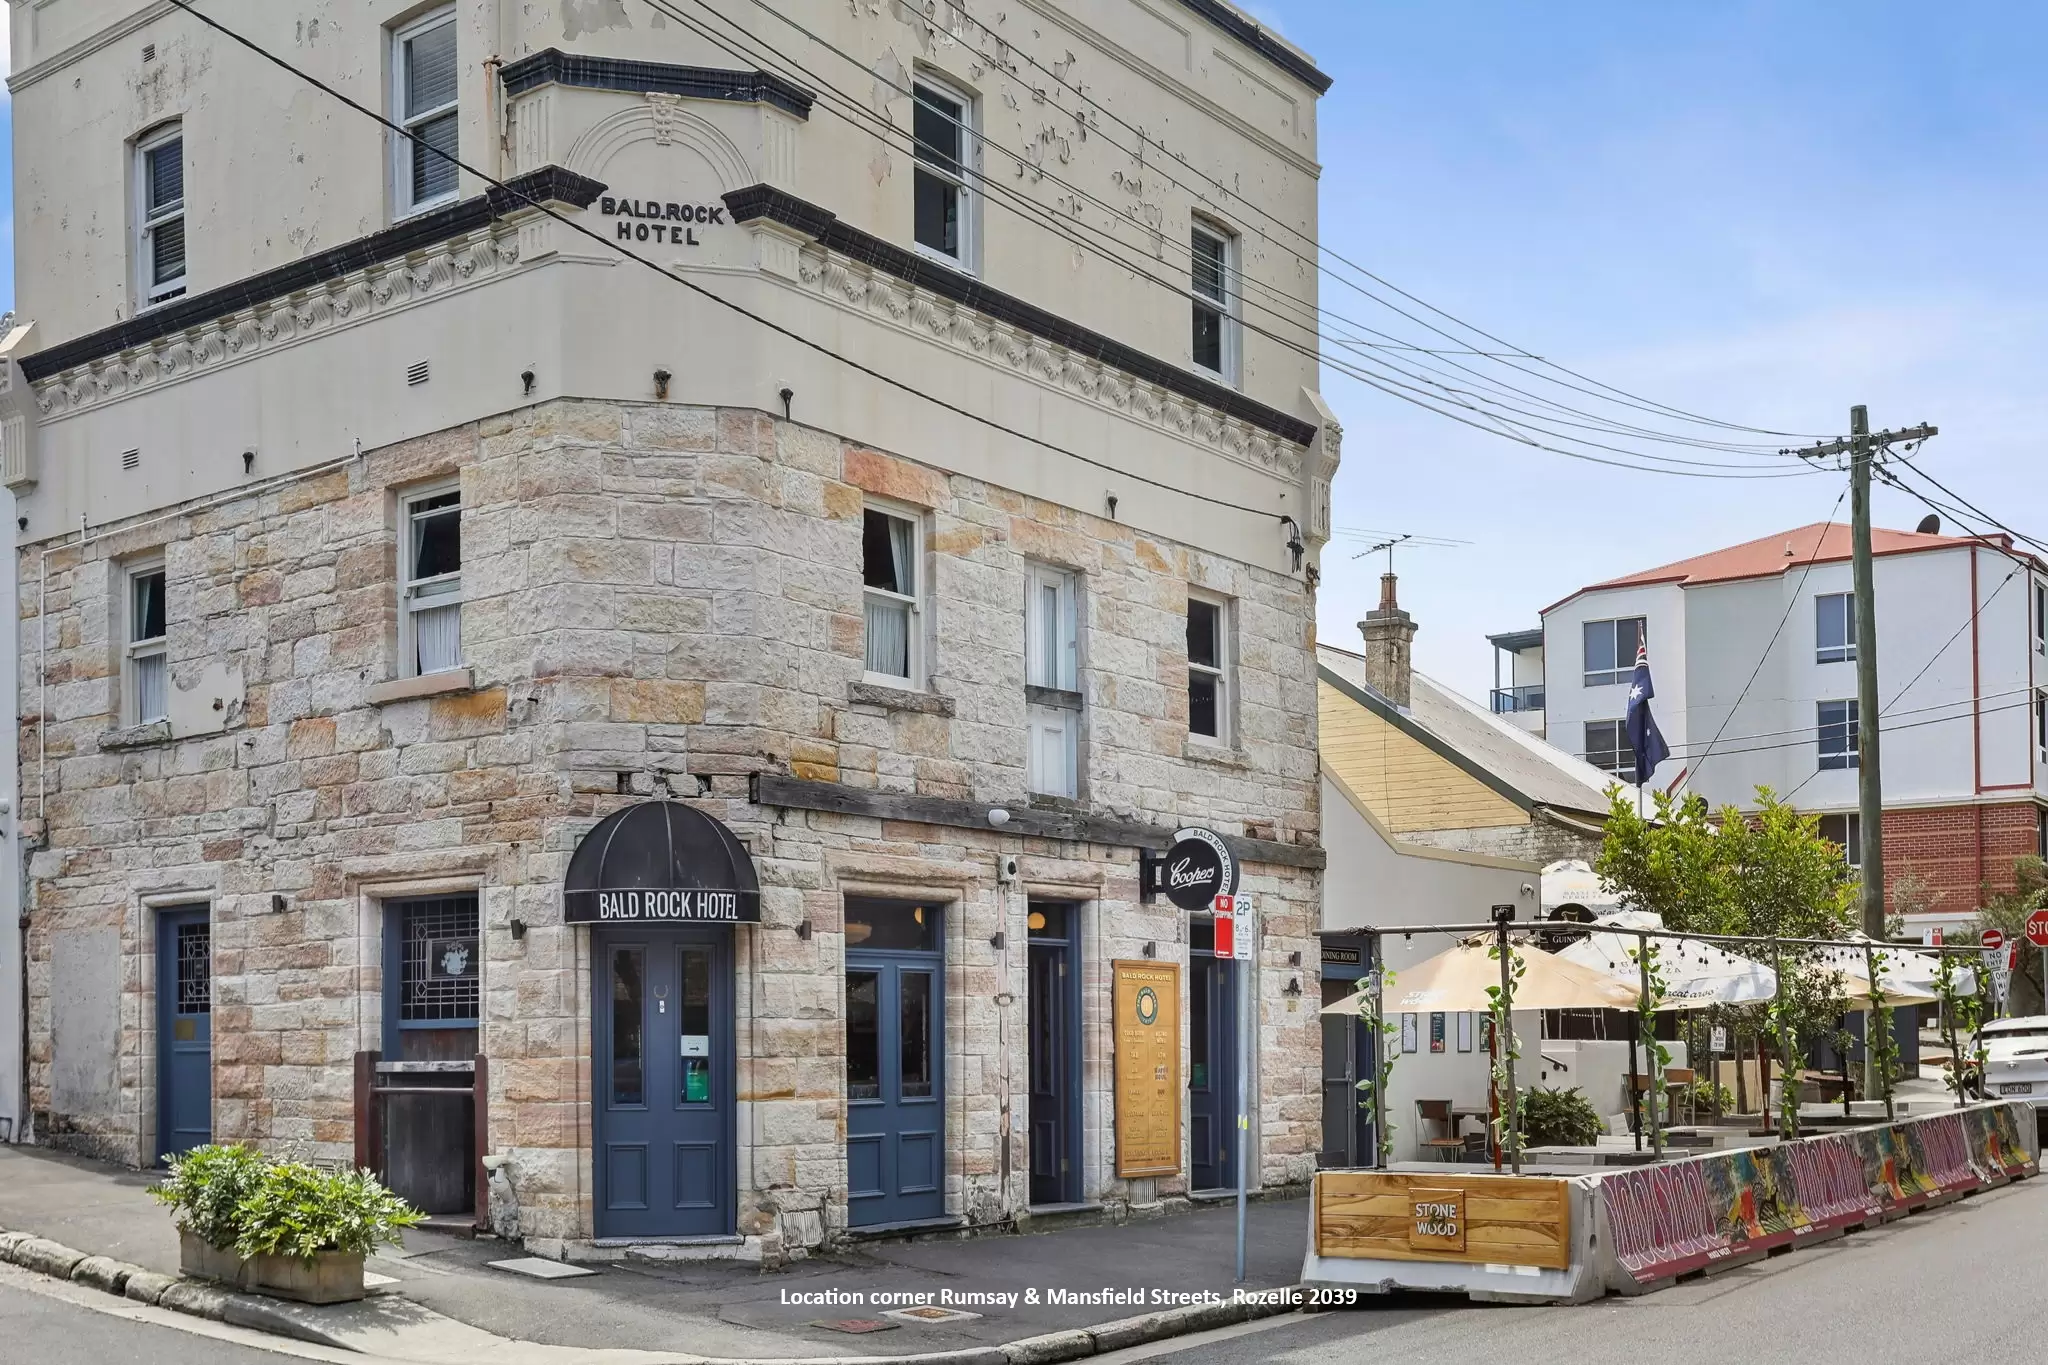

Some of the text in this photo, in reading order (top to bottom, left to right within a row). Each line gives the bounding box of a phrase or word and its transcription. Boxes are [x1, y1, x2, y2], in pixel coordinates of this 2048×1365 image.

[617, 221, 699, 246] HOTEL
[1193, 829, 1231, 893] BALD ROCK HOTEL
[1170, 857, 1215, 888] Coopers
[600, 891, 738, 920] BALD ROCK HOTEL
[1236, 901, 1251, 917] 2P
[1340, 952, 1357, 961] ROOM
[1416, 1203, 1457, 1218] STONE
[1416, 1221, 1457, 1236] WOOD
